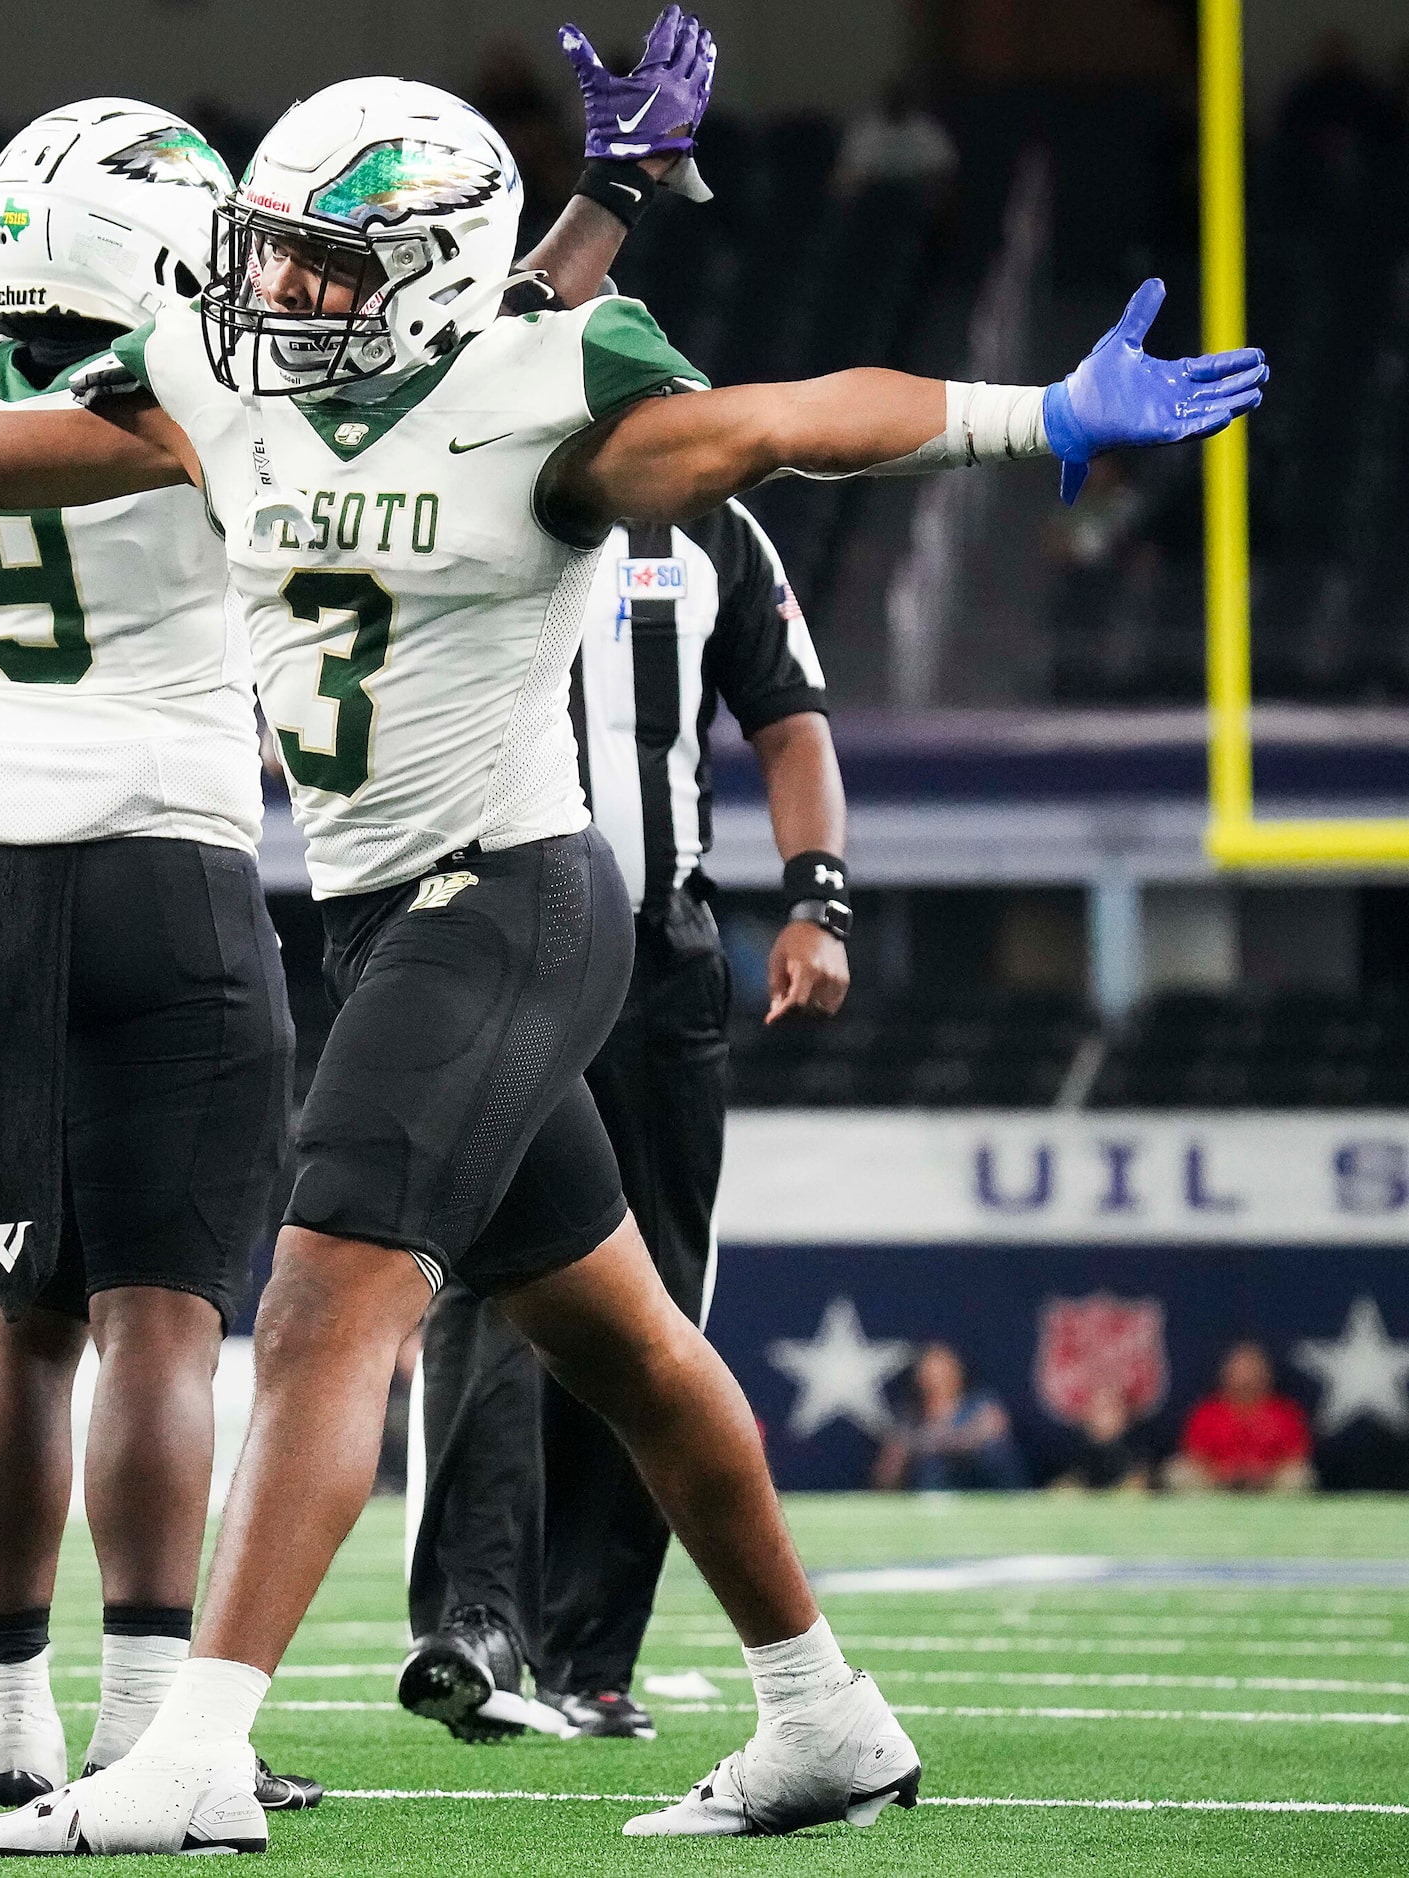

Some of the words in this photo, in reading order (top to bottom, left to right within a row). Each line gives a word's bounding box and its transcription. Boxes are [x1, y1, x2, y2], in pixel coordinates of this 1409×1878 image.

[247, 190, 291, 213] Riddell
[249, 488, 439, 555] SOTO
[275, 566, 399, 806] 3
[973, 1141, 1247, 1213] UIL
